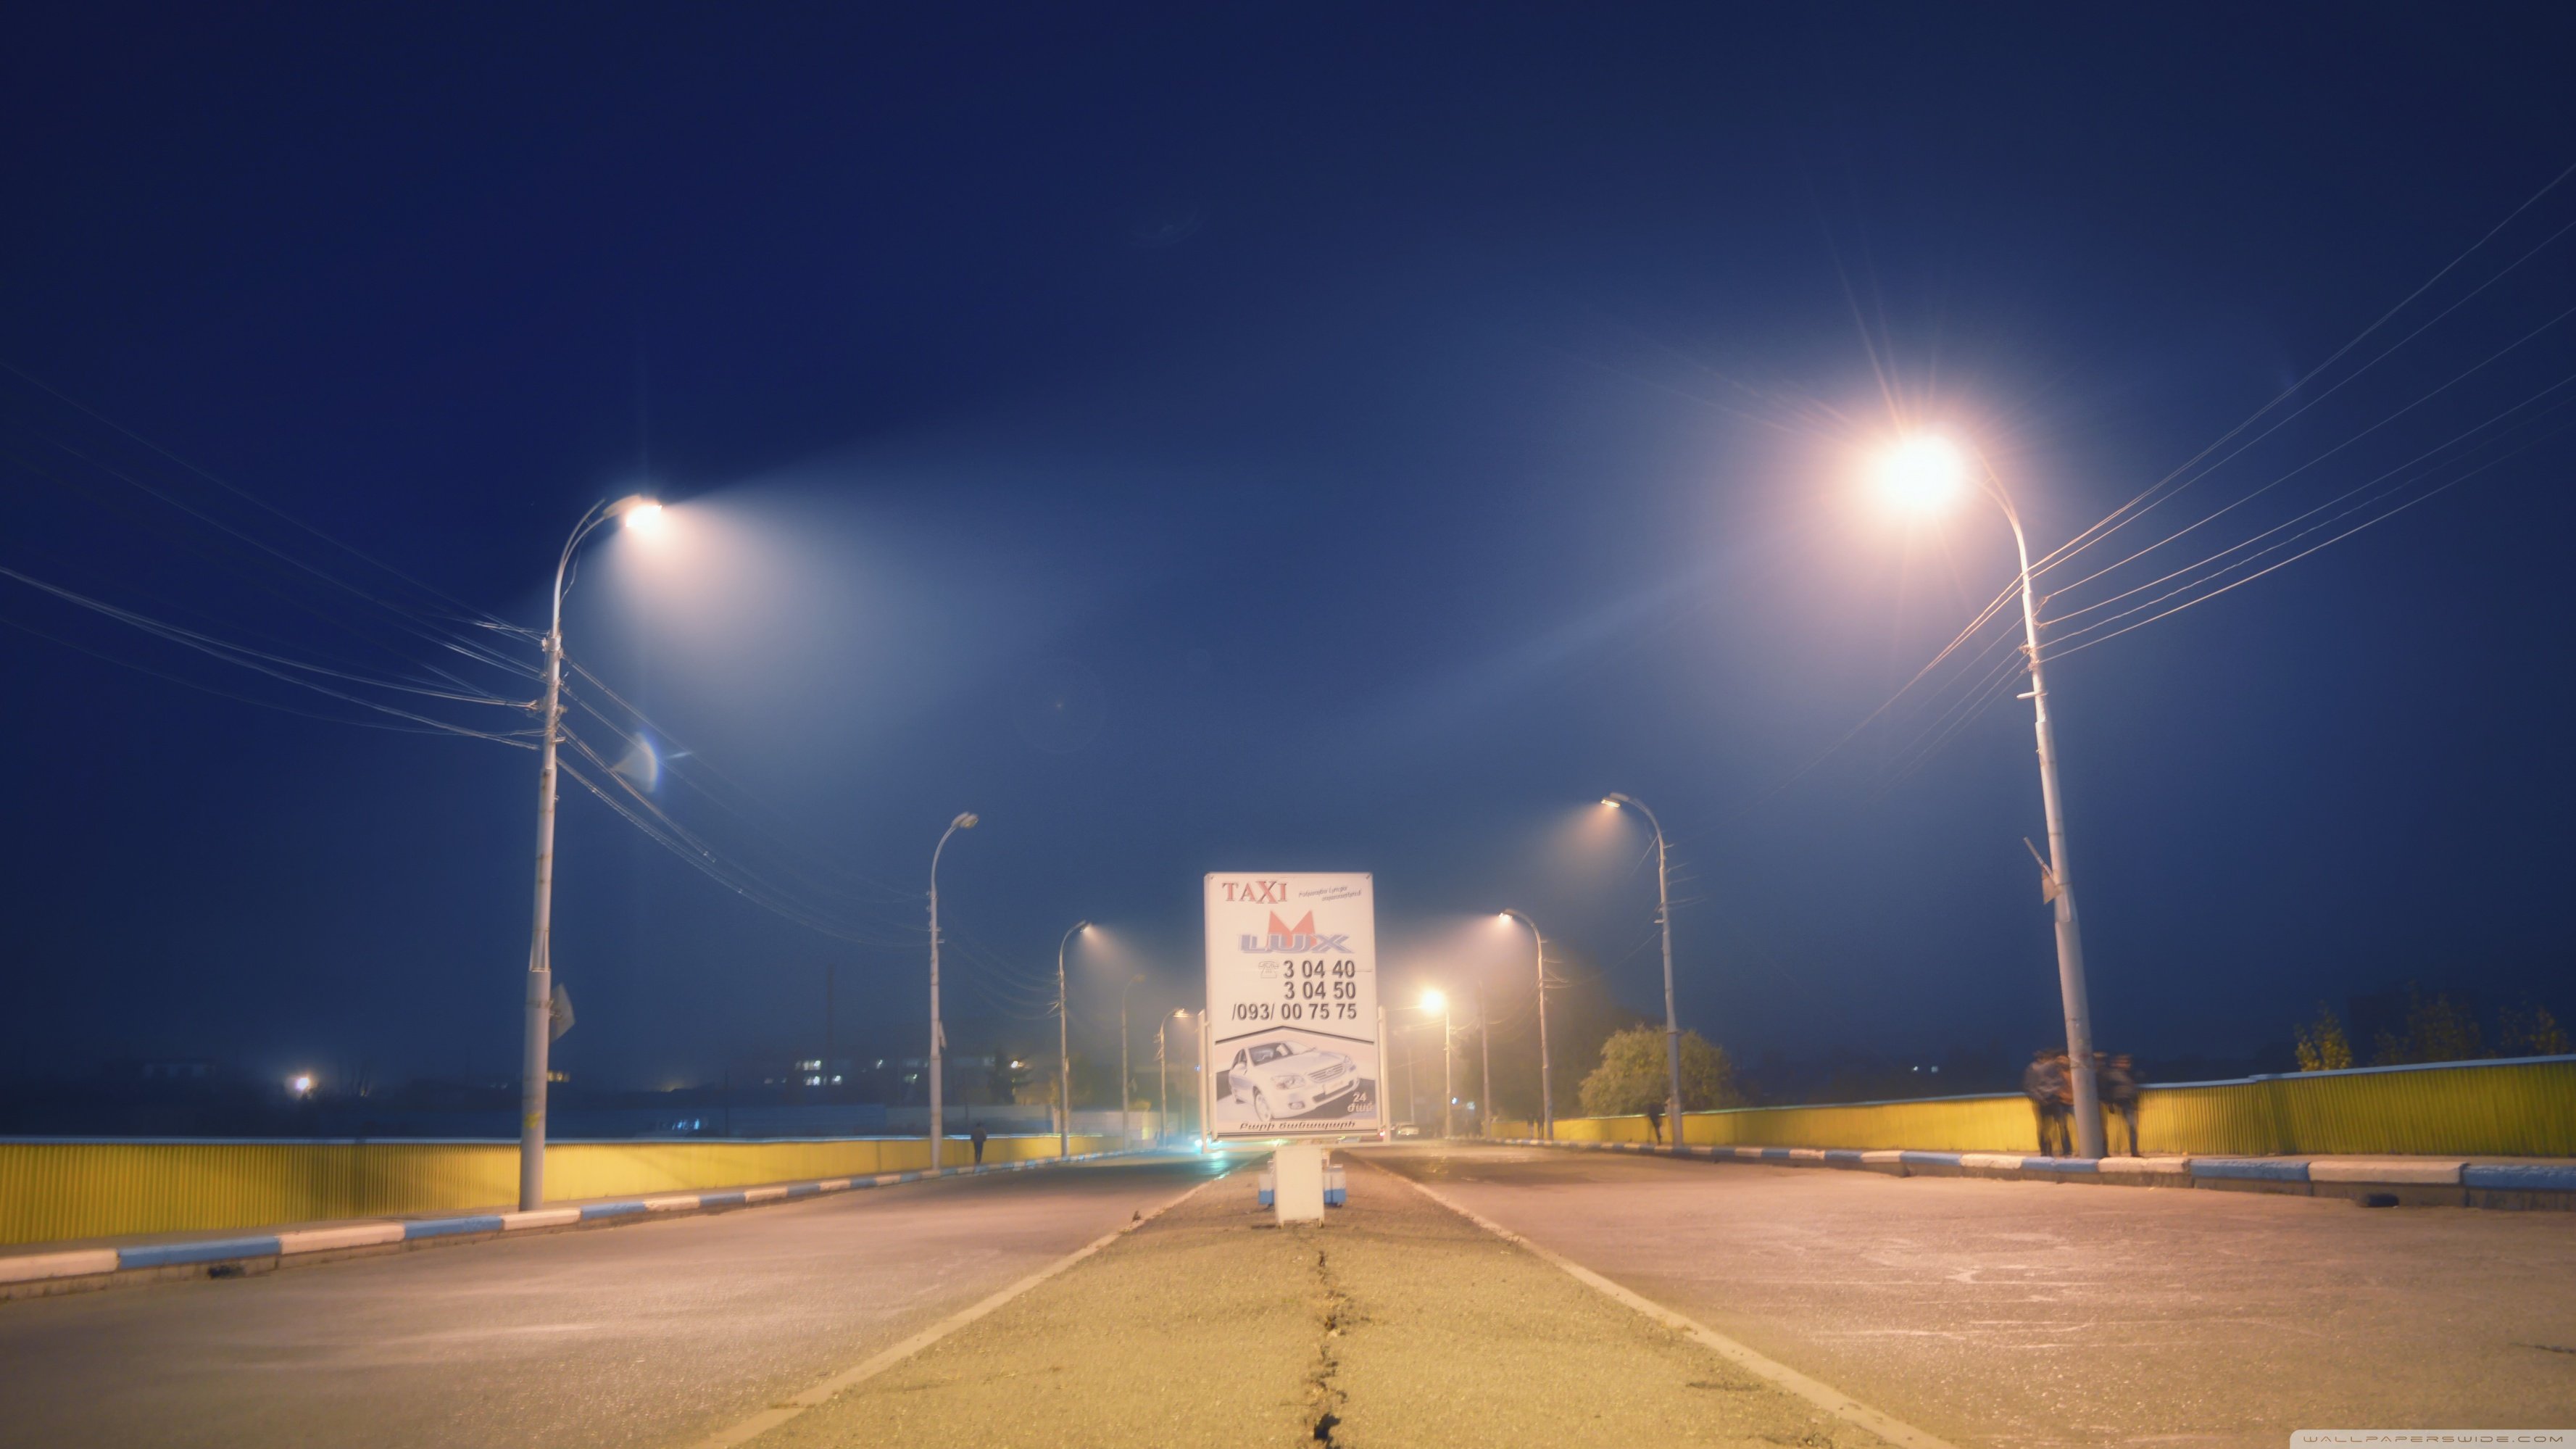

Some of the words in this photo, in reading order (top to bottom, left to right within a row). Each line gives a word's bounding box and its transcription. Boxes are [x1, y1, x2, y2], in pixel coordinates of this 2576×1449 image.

[1222, 881, 1287, 904] TAXI
[1238, 934, 1355, 954] LUX
[1283, 960, 1295, 979] 3
[1302, 960, 1326, 979] 04
[1331, 960, 1355, 979] 40
[1284, 981, 1295, 1000] 3
[1302, 981, 1326, 1000] 04
[1333, 981, 1356, 1000] 50
[1231, 1003, 1275, 1021] /093/
[1281, 1003, 1302, 1020] 00
[1308, 1003, 1329, 1020] 75
[1336, 1003, 1357, 1020] 75
[1353, 1092, 1368, 1103] 24
